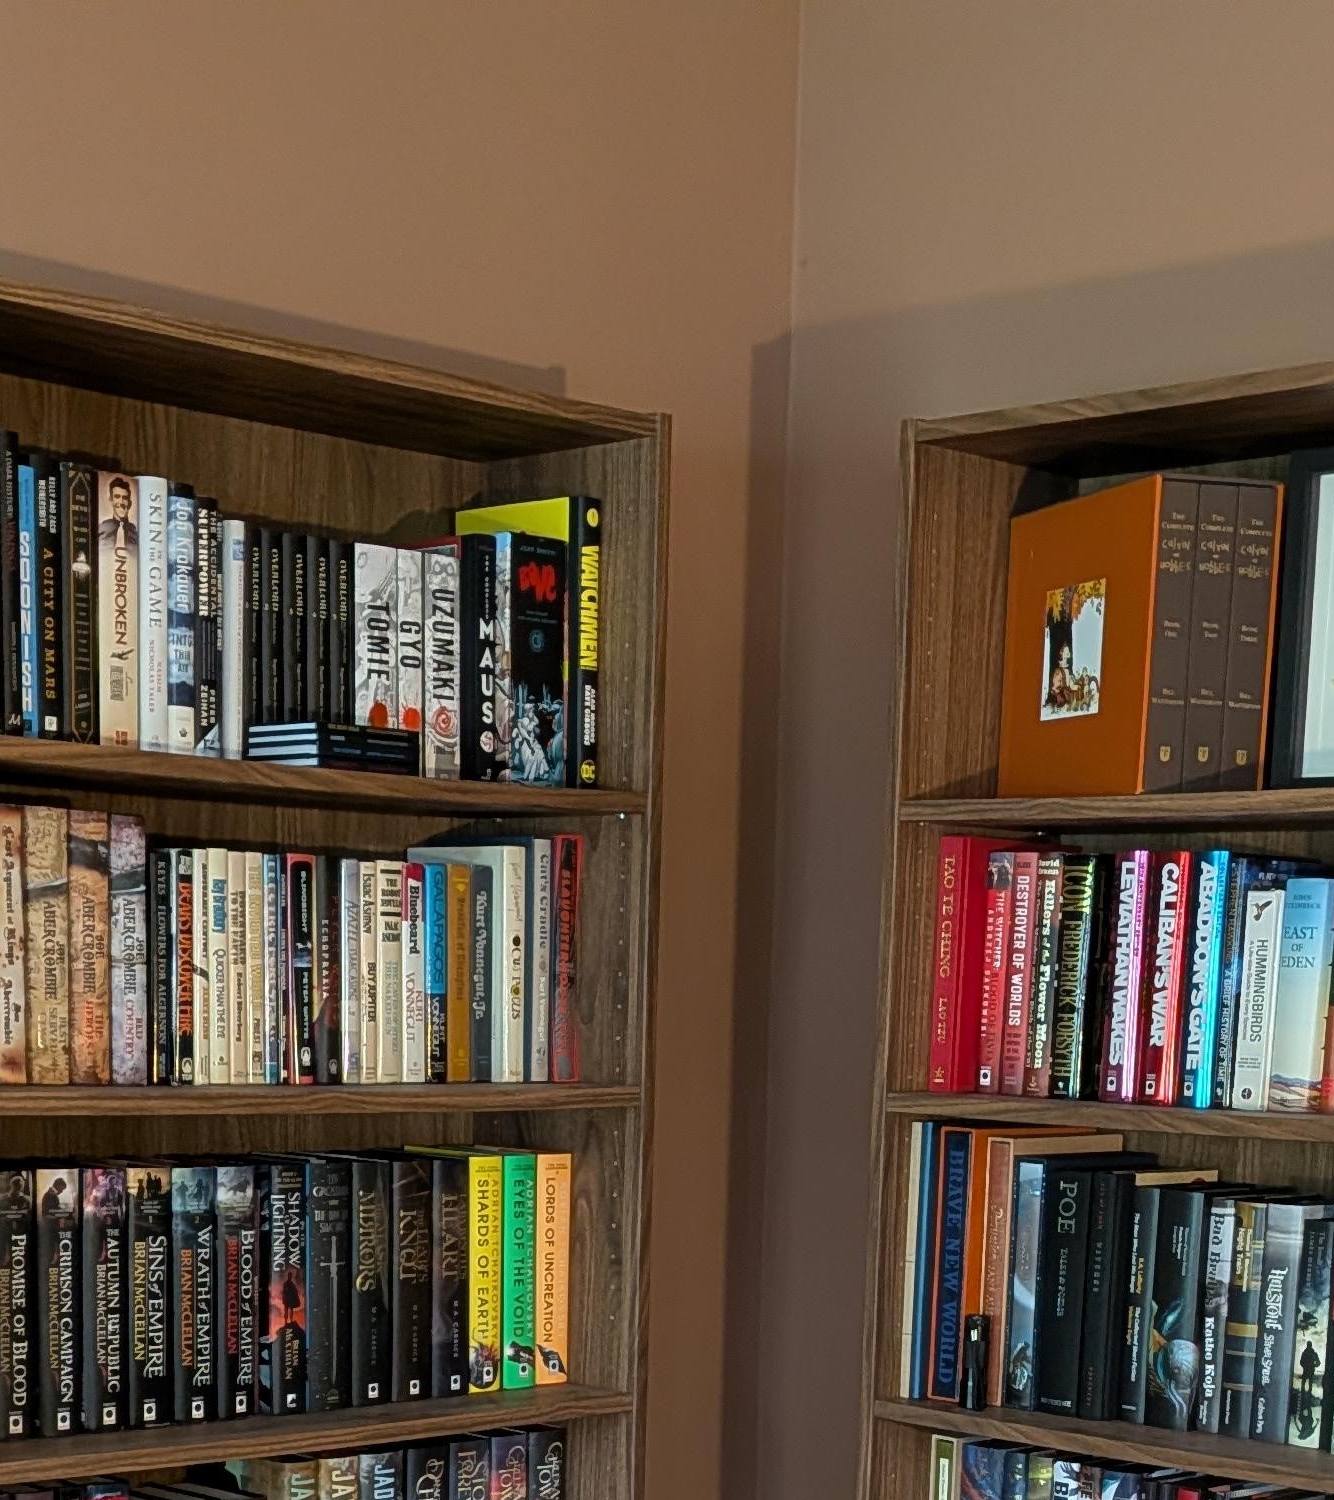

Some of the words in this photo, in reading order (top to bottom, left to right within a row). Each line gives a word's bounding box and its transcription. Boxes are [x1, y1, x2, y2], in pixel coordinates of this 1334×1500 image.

[43, 548, 53, 560] A
[44, 567, 55, 611] CITY
[114, 546, 127, 646] UNBROKEN
[579, 545, 599, 667] WATCHMEN
[44, 617, 55, 642] ON
[366, 602, 389, 681] TOMIE
[399, 620, 421, 669] GYO
[431, 588, 455, 701] UZUMAKI
[44, 648, 55, 699] MARS
[409, 885, 420, 954] Bluebeard
[1013, 875, 1030, 950] DESTROYER
[1113, 861, 1137, 989] LEVIATHAN
[1153, 863, 1179, 988] CALIBAN'S
[1191, 861, 1217, 1008] ABADDON'S
[123, 899, 137, 995] ABERCROMBIE
[1012, 953, 1025, 970] OF
[1008, 973, 1025, 1026] WORLDS
[1149, 989, 1169, 1047] WAR
[1249, 939, 1268, 1043] HUMMINGBIRDS
[1108, 989, 1127, 1066] WAKES
[1185, 1008, 1206, 1071] GATE
[545, 1177, 556, 1223] LORDS
[946, 1150, 964, 1227] BRAVE
[1057, 1180, 1078, 1234] POE
[134, 1241, 146, 1284] BRIAN
[147, 1236, 166, 1282] SINS
[545, 1228, 555, 1247] OF
[943, 1238, 961, 1293] NEW
[11, 1234, 26, 1309] PROMISE
[148, 1283, 161, 1297] of
[543, 1252, 554, 1343] UNCREATION
[12, 1315, 26, 1336] OF
[143, 1298, 165, 1378] EMPIRE
[939, 1301, 957, 1384] WORLD
[12, 1341, 28, 1406] BLOOD
